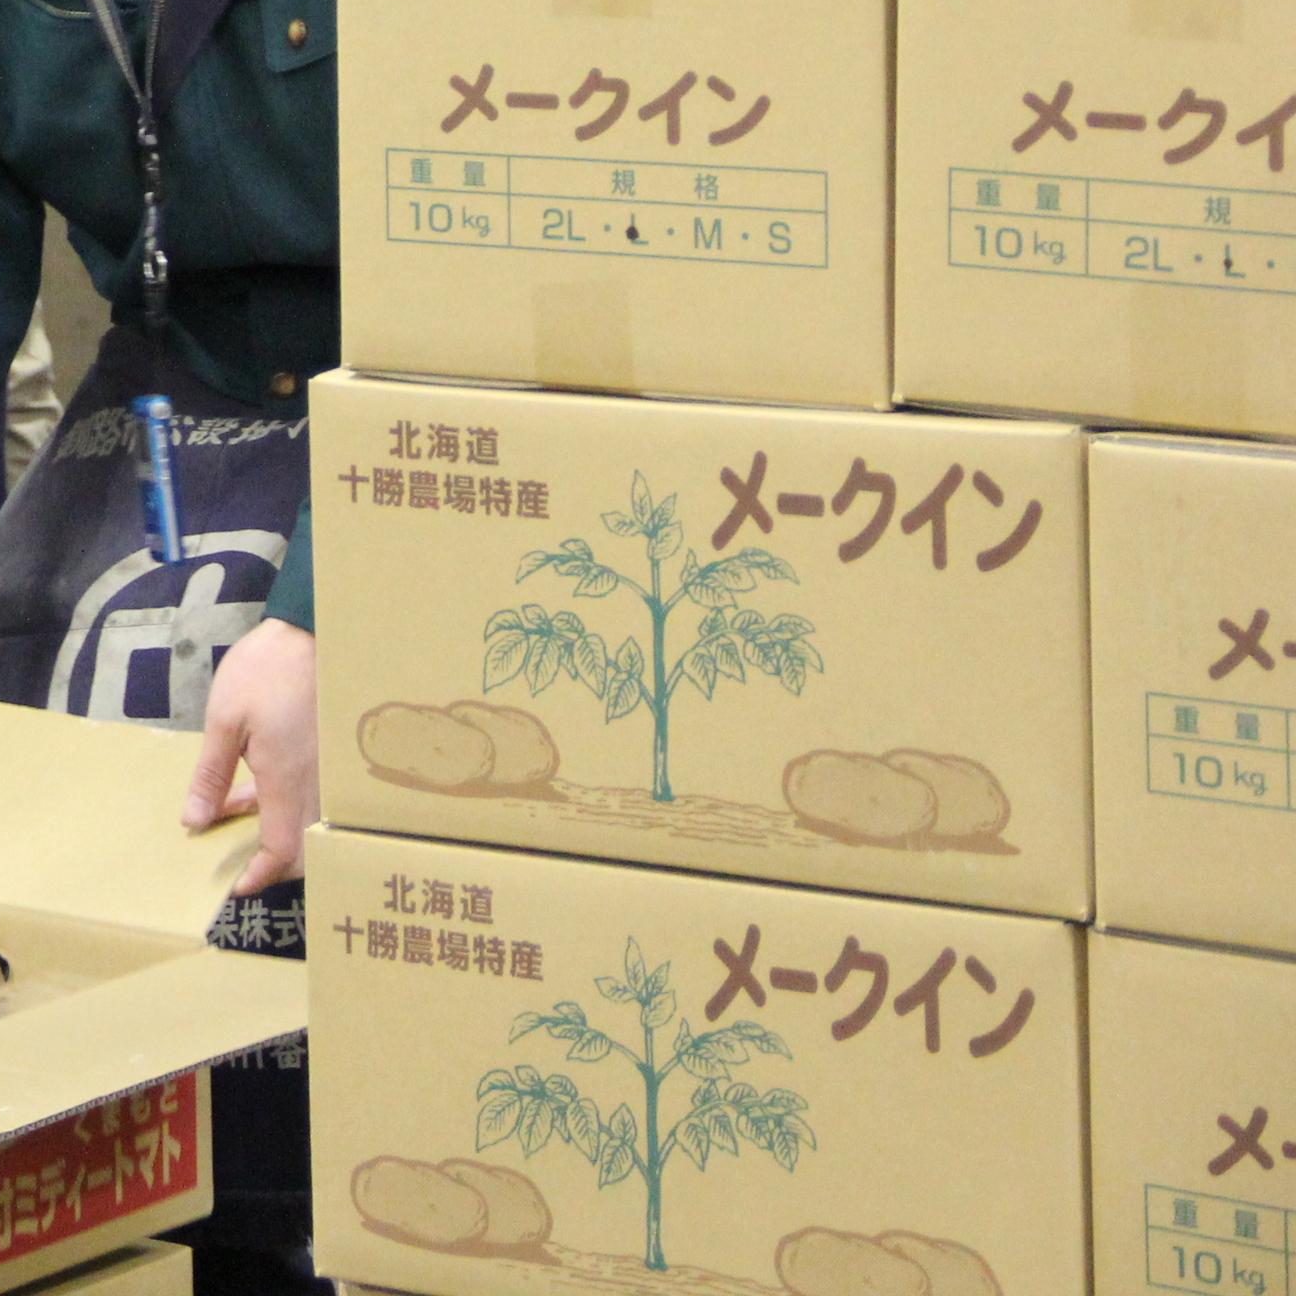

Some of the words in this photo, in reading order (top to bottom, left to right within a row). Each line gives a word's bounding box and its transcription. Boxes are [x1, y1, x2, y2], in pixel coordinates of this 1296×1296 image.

[440, 63, 771, 146] メークイン
[409, 159, 487, 188] 重量
[611, 169, 719, 201] 規格
[388, 420, 500, 467] 北海道
[337, 465, 551, 521] 十勝農場特産
[711, 449, 1043, 573] メークイン
[1208, 608, 1296, 680] メ
[382, 872, 495, 925] 北海道
[332, 915, 545, 982] 十勝農場特産
[704, 923, 1036, 1058] メークイン
[1208, 1106, 1296, 1177] メ
